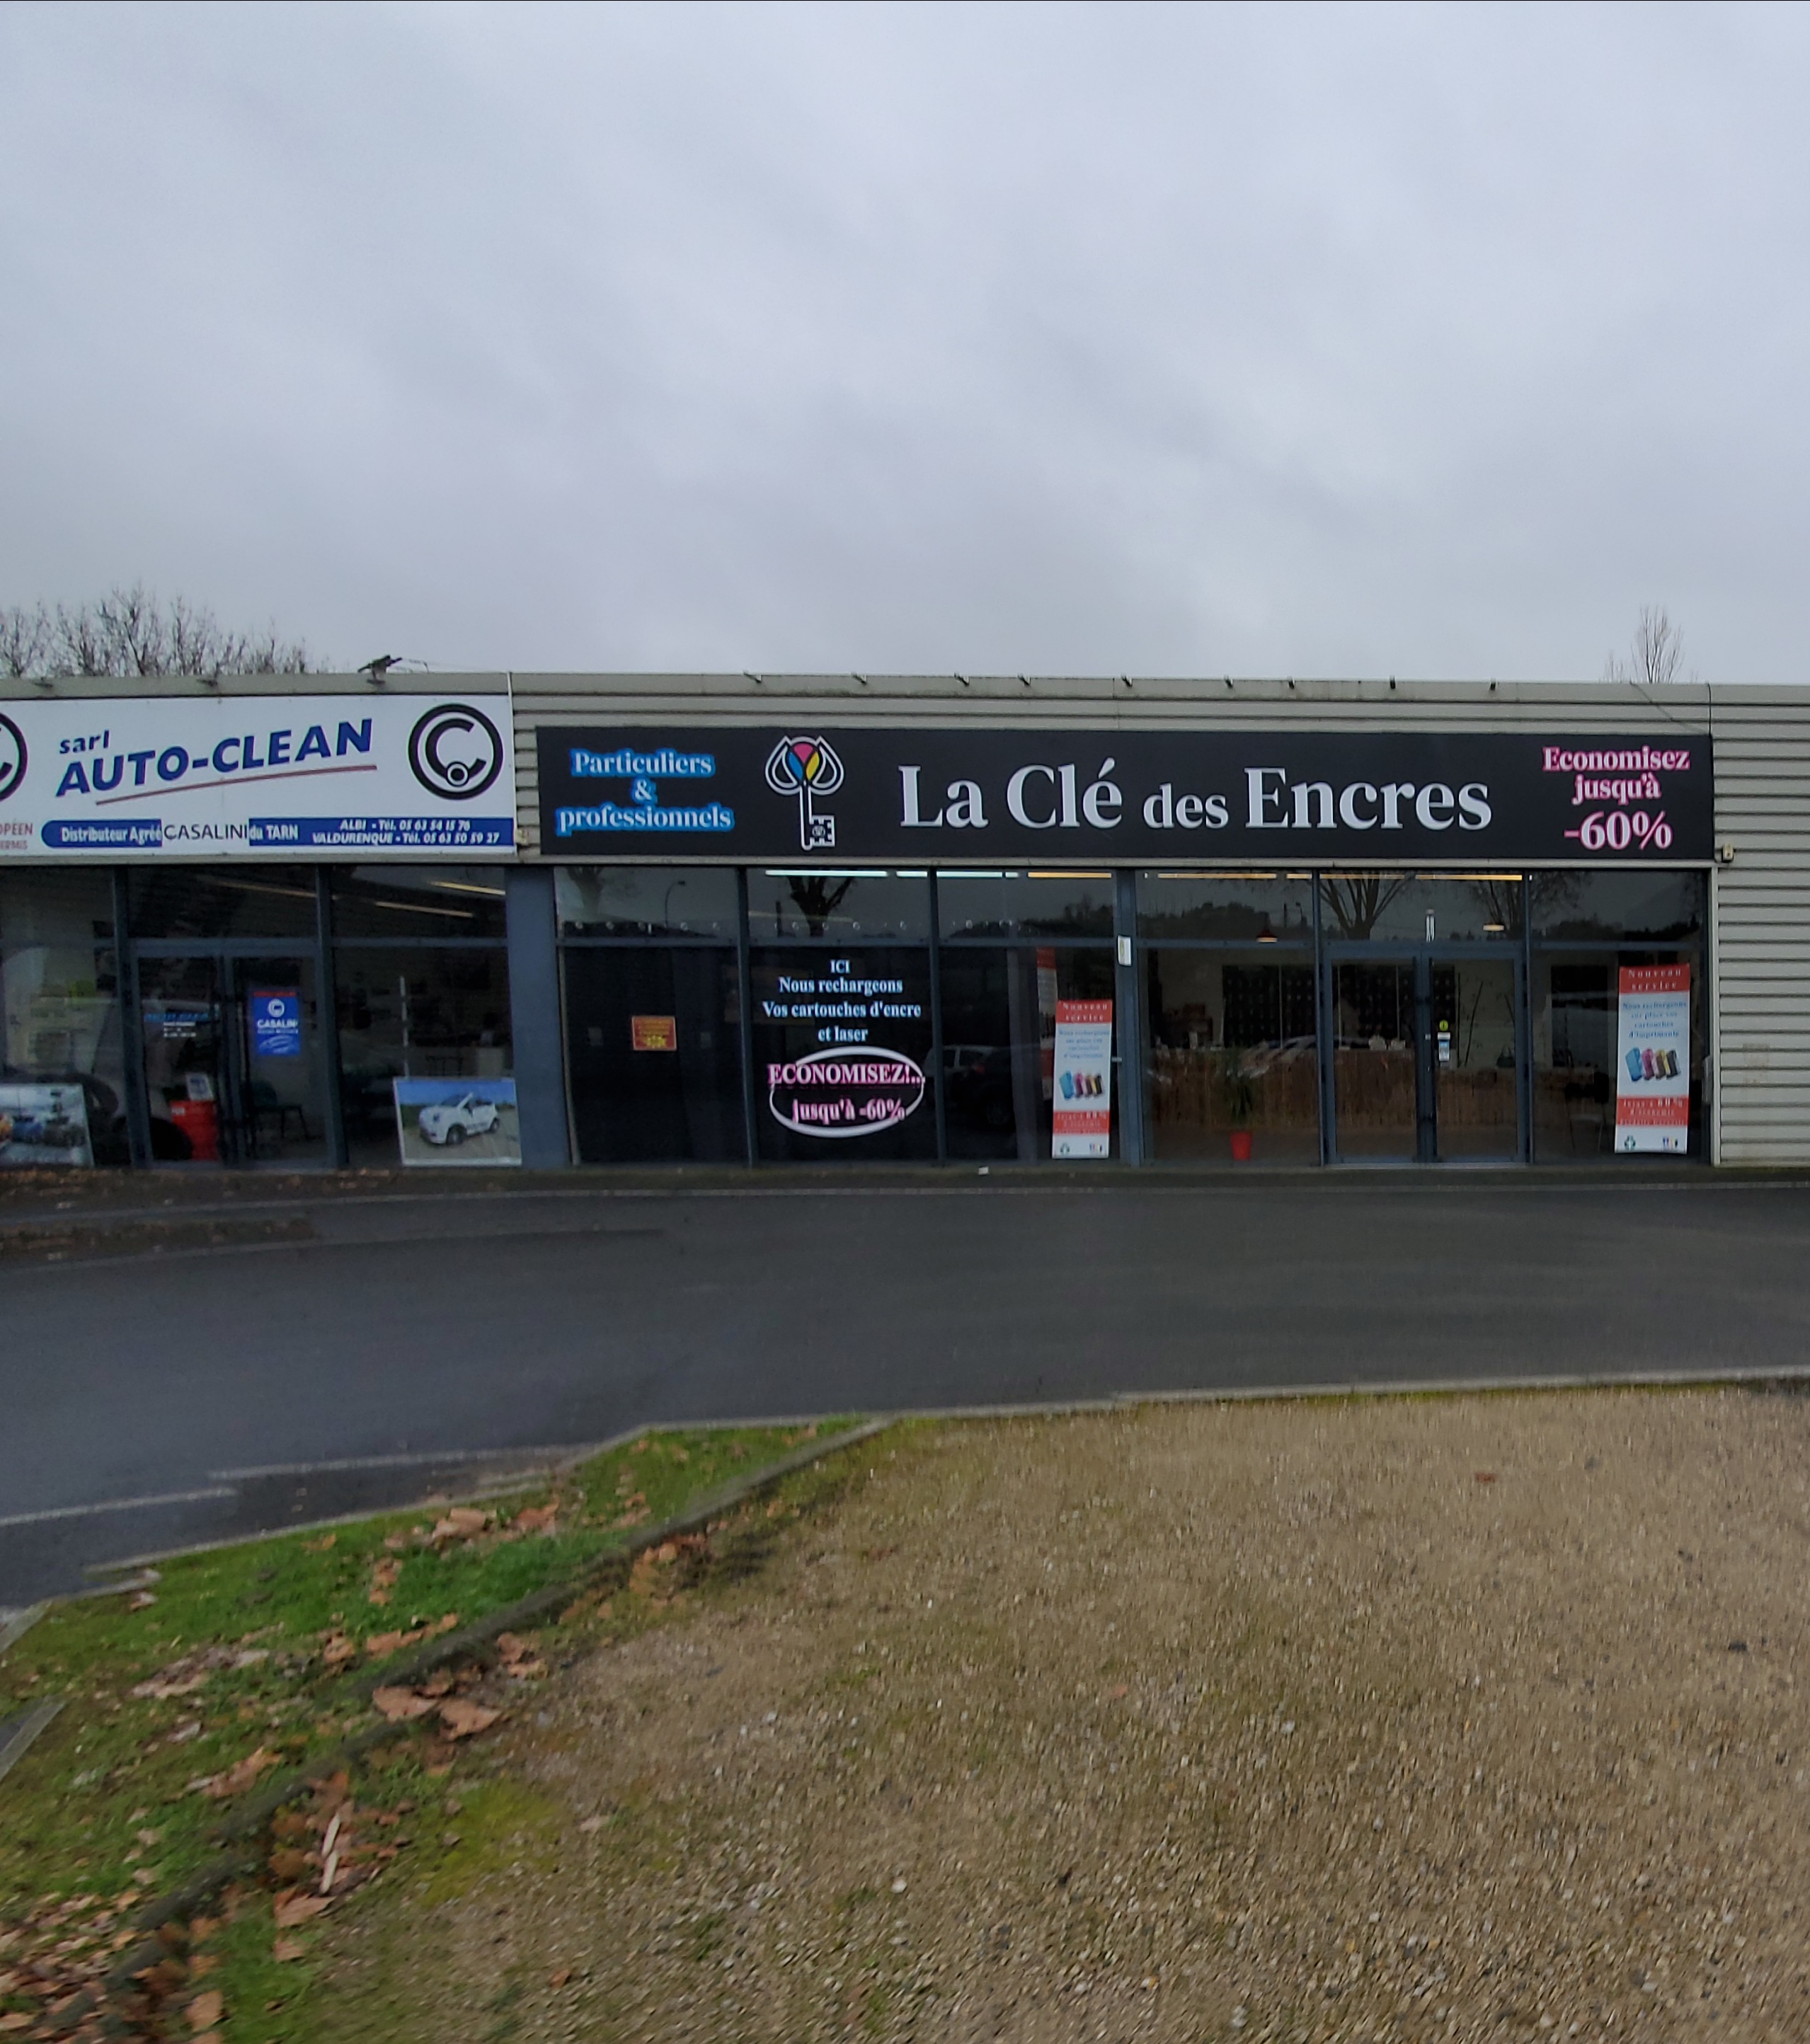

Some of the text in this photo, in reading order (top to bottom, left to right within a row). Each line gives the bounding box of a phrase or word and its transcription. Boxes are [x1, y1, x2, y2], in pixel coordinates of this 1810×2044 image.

[59, 730, 110, 754] sarl
[56, 718, 372, 798] AUTO-CLEAN
[573, 750, 714, 775] Particuliers
[1542, 745, 1690, 771] Economisez
[634, 779, 654, 801] &
[898, 757, 1492, 830] La Clé des Encres
[1571, 772, 1662, 805] jusqu'à
[339, 819, 366, 831] ALBI
[558, 805, 733, 834] professionnels
[1564, 810, 1673, 850] -60%
[61, 827, 127, 842] Distributeur
[164, 824, 248, 840] CASALINI
[250, 825, 263, 841] du
[266, 825, 298, 840] TARN
[830, 959, 850, 974] ICI
[779, 977, 903, 997] Nous rechargeons
[762, 1001, 922, 1018] Vos cartouches d'encre
[818, 1026, 869, 1042] et laser
[859, 1098, 907, 1120] -60%
